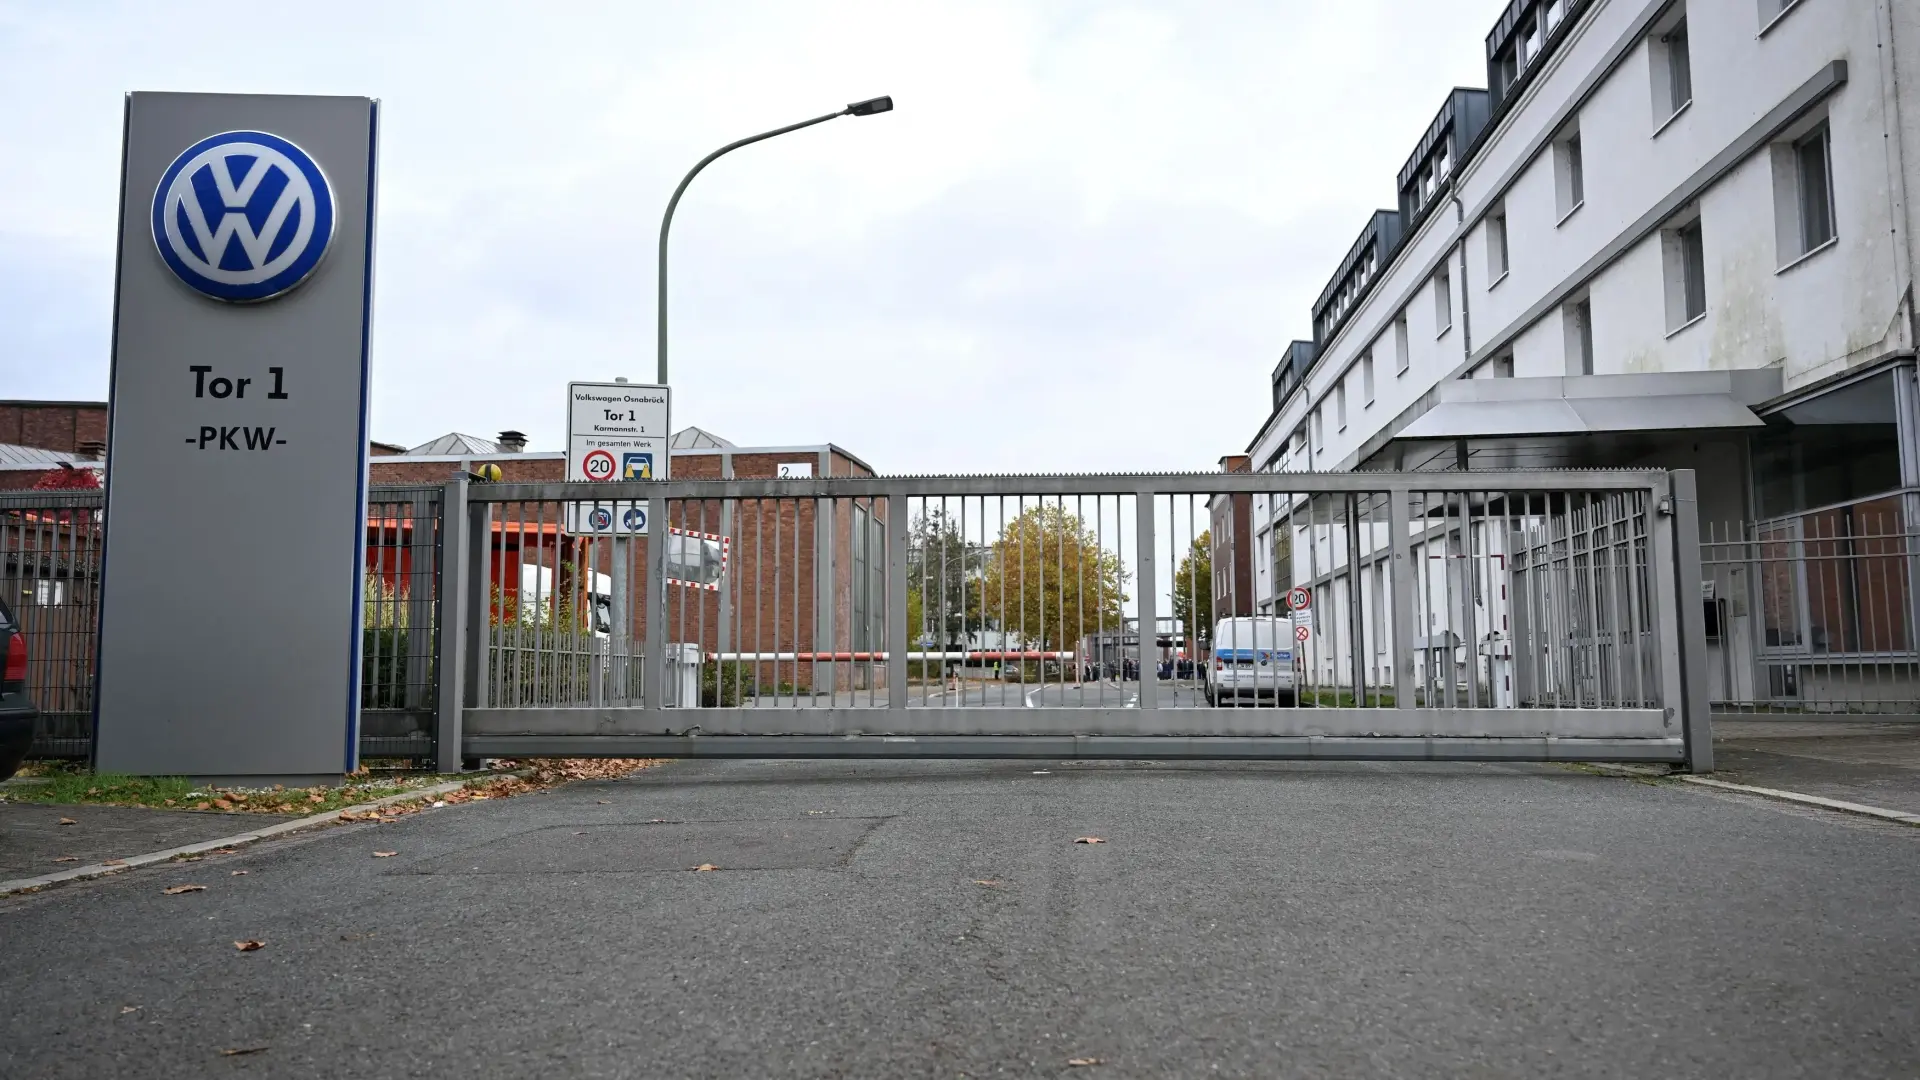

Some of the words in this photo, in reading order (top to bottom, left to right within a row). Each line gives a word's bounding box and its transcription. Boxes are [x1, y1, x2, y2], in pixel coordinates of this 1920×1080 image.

[164, 142, 315, 284] VW
[190, 365, 251, 399] Tor
[267, 367, 289, 400] 1
[575, 393, 622, 403] Volkswagen
[623, 395, 665, 404] Osnabrück
[603, 409, 624, 421] Tor
[628, 410, 636, 422] 1
[594, 424, 639, 433] Karmannstr.
[640, 425, 645, 433] 1
[185, 426, 287, 451] -PKW-
[597, 440, 631, 448] gesamten
[590, 459, 610, 473] 20
